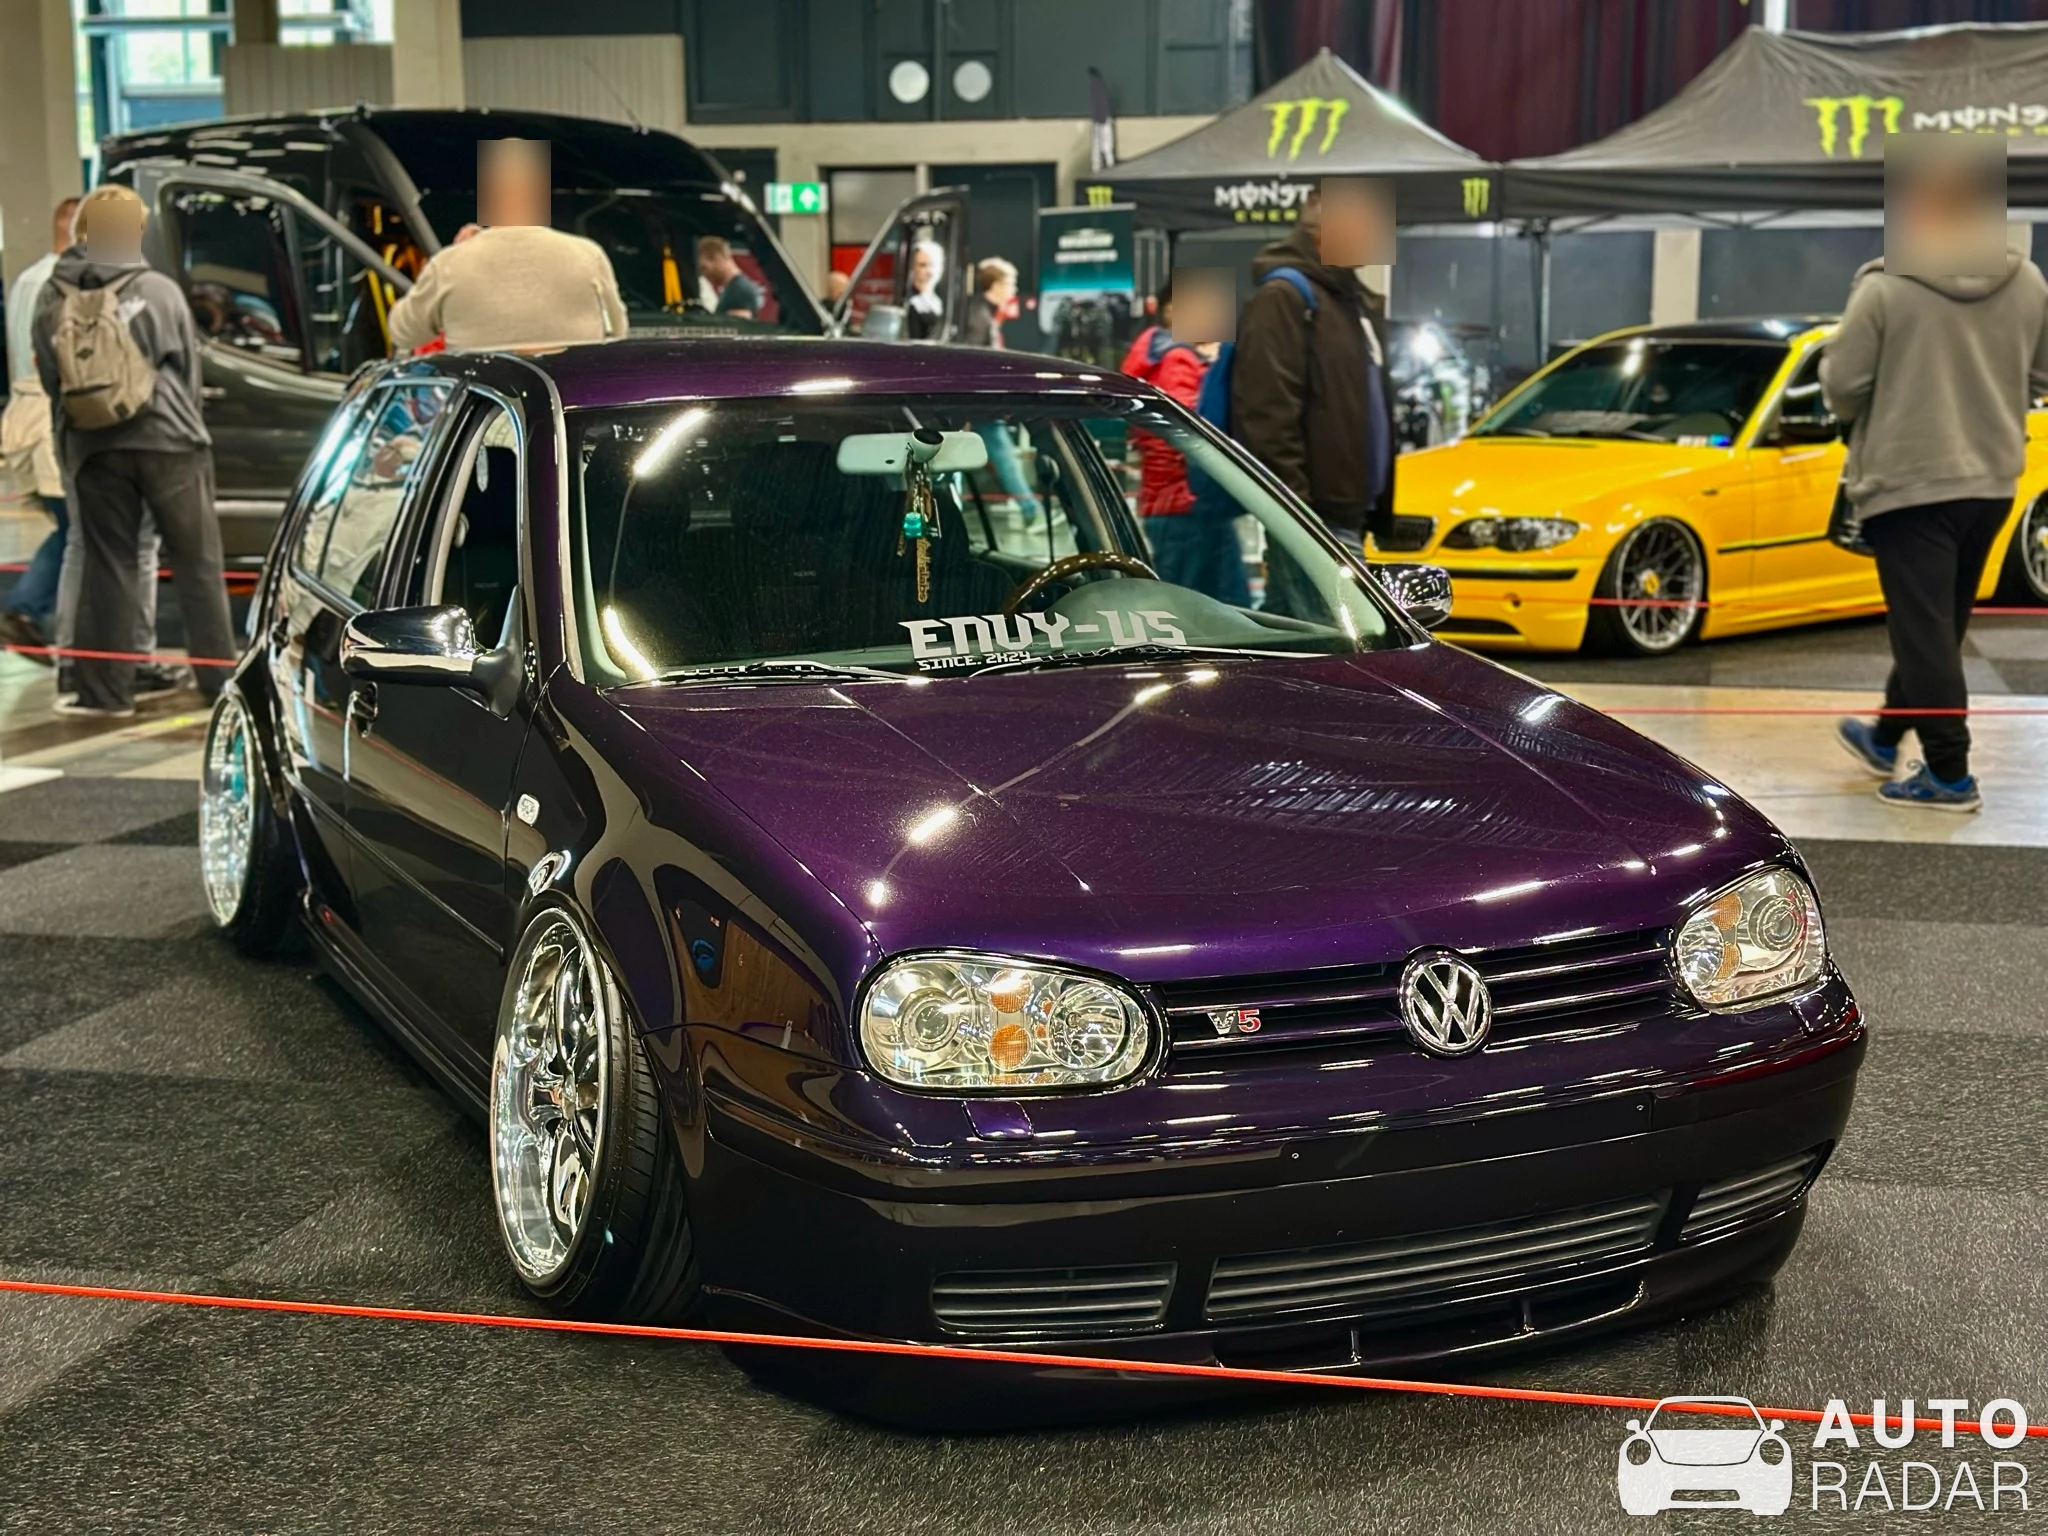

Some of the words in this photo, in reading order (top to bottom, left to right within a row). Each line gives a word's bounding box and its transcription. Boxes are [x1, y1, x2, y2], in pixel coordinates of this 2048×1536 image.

[1913, 102, 2048, 131] MONS
[1214, 181, 1315, 209] MONST
[898, 611, 1187, 659] ENVY-US
[916, 655, 982, 671] SINCE.
[1207, 1009, 1261, 1035] V5
